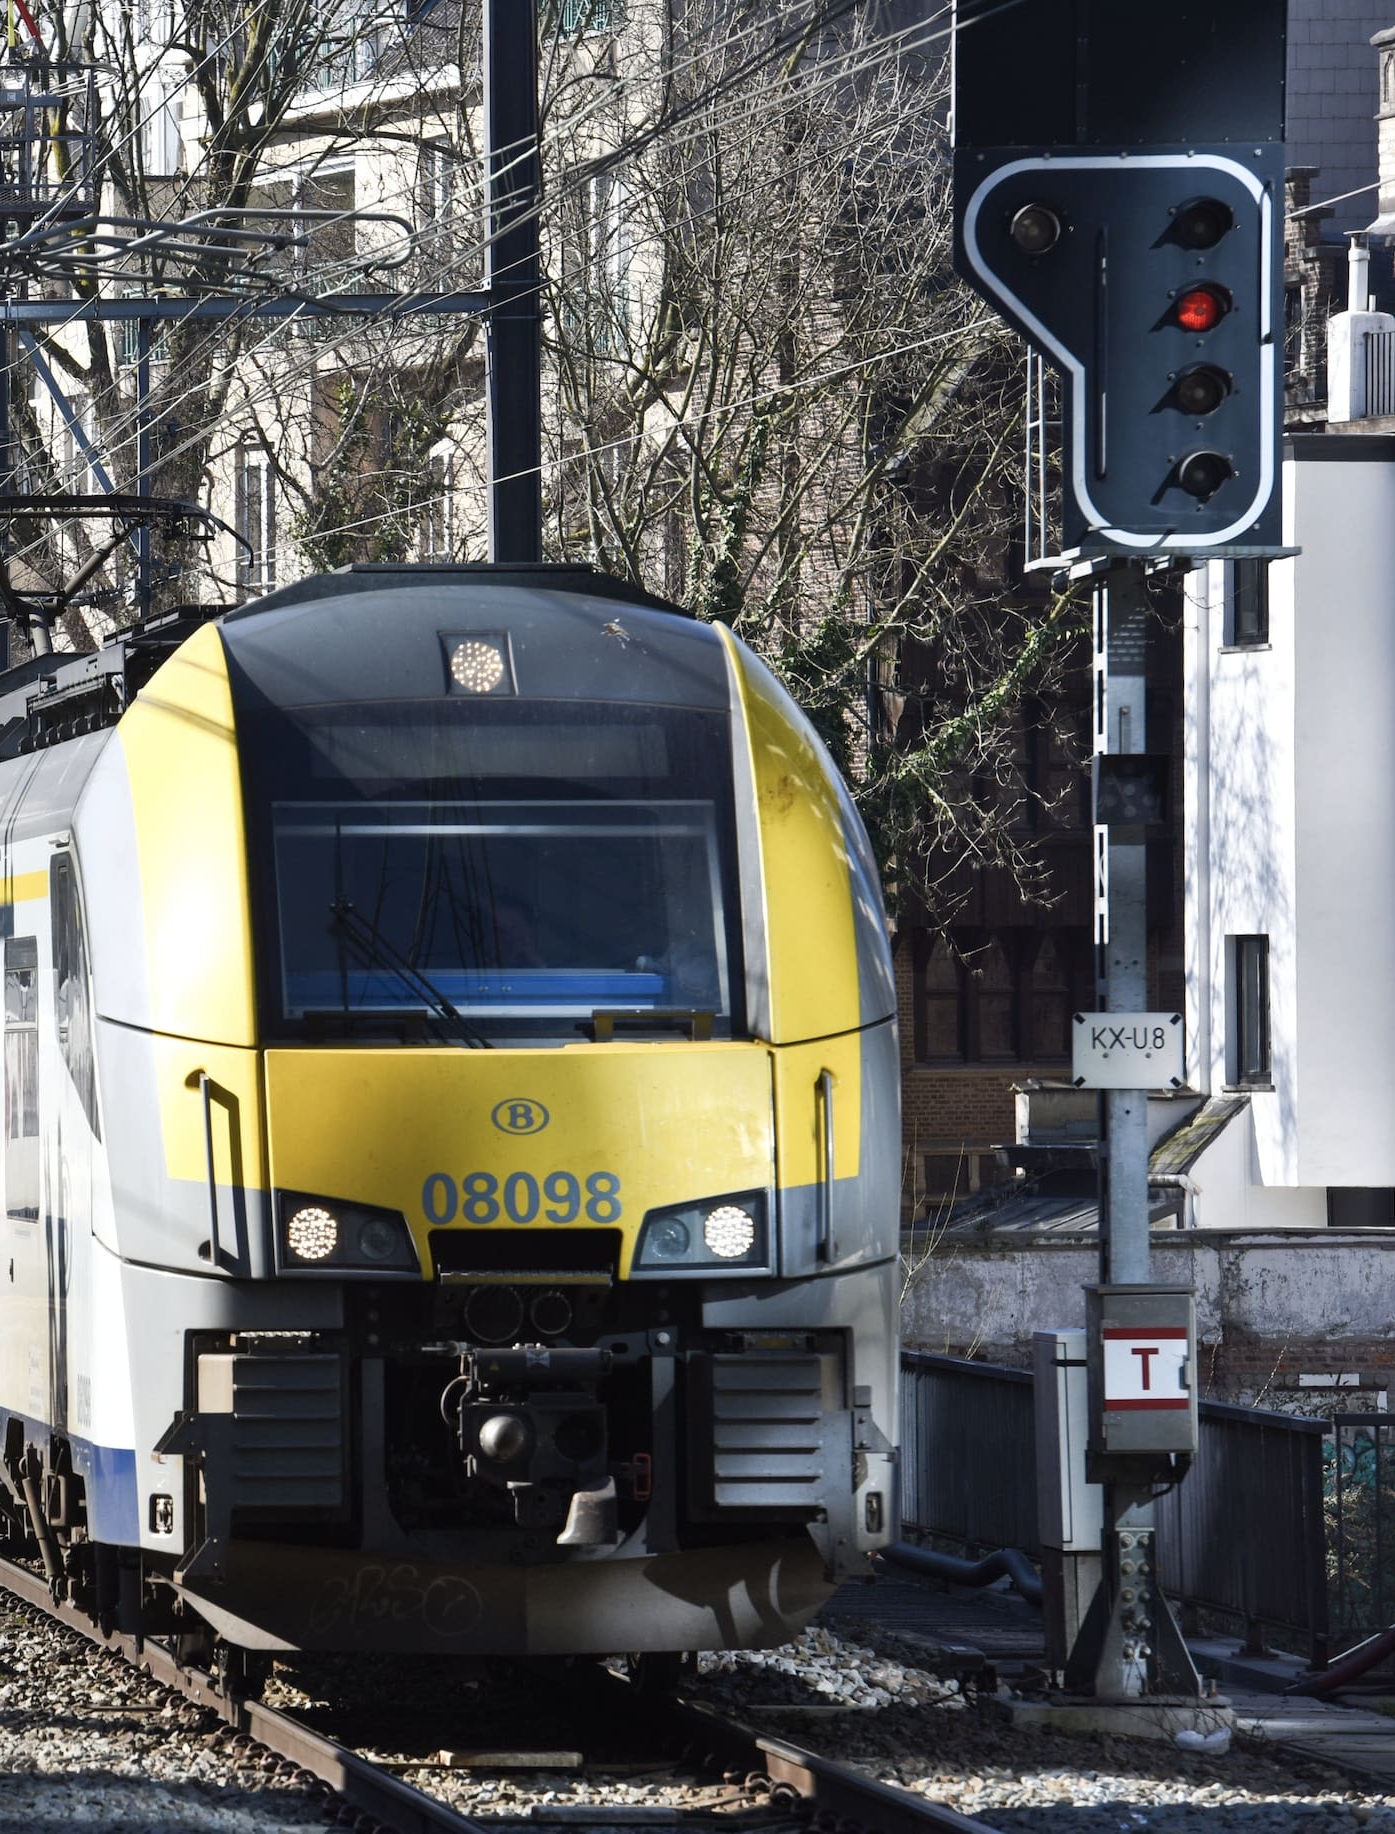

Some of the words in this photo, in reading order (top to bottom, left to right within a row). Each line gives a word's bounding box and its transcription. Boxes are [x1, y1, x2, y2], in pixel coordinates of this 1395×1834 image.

[508, 1103, 535, 1129] B
[422, 1171, 622, 1225] 08098
[1131, 1348, 1159, 1390] T
